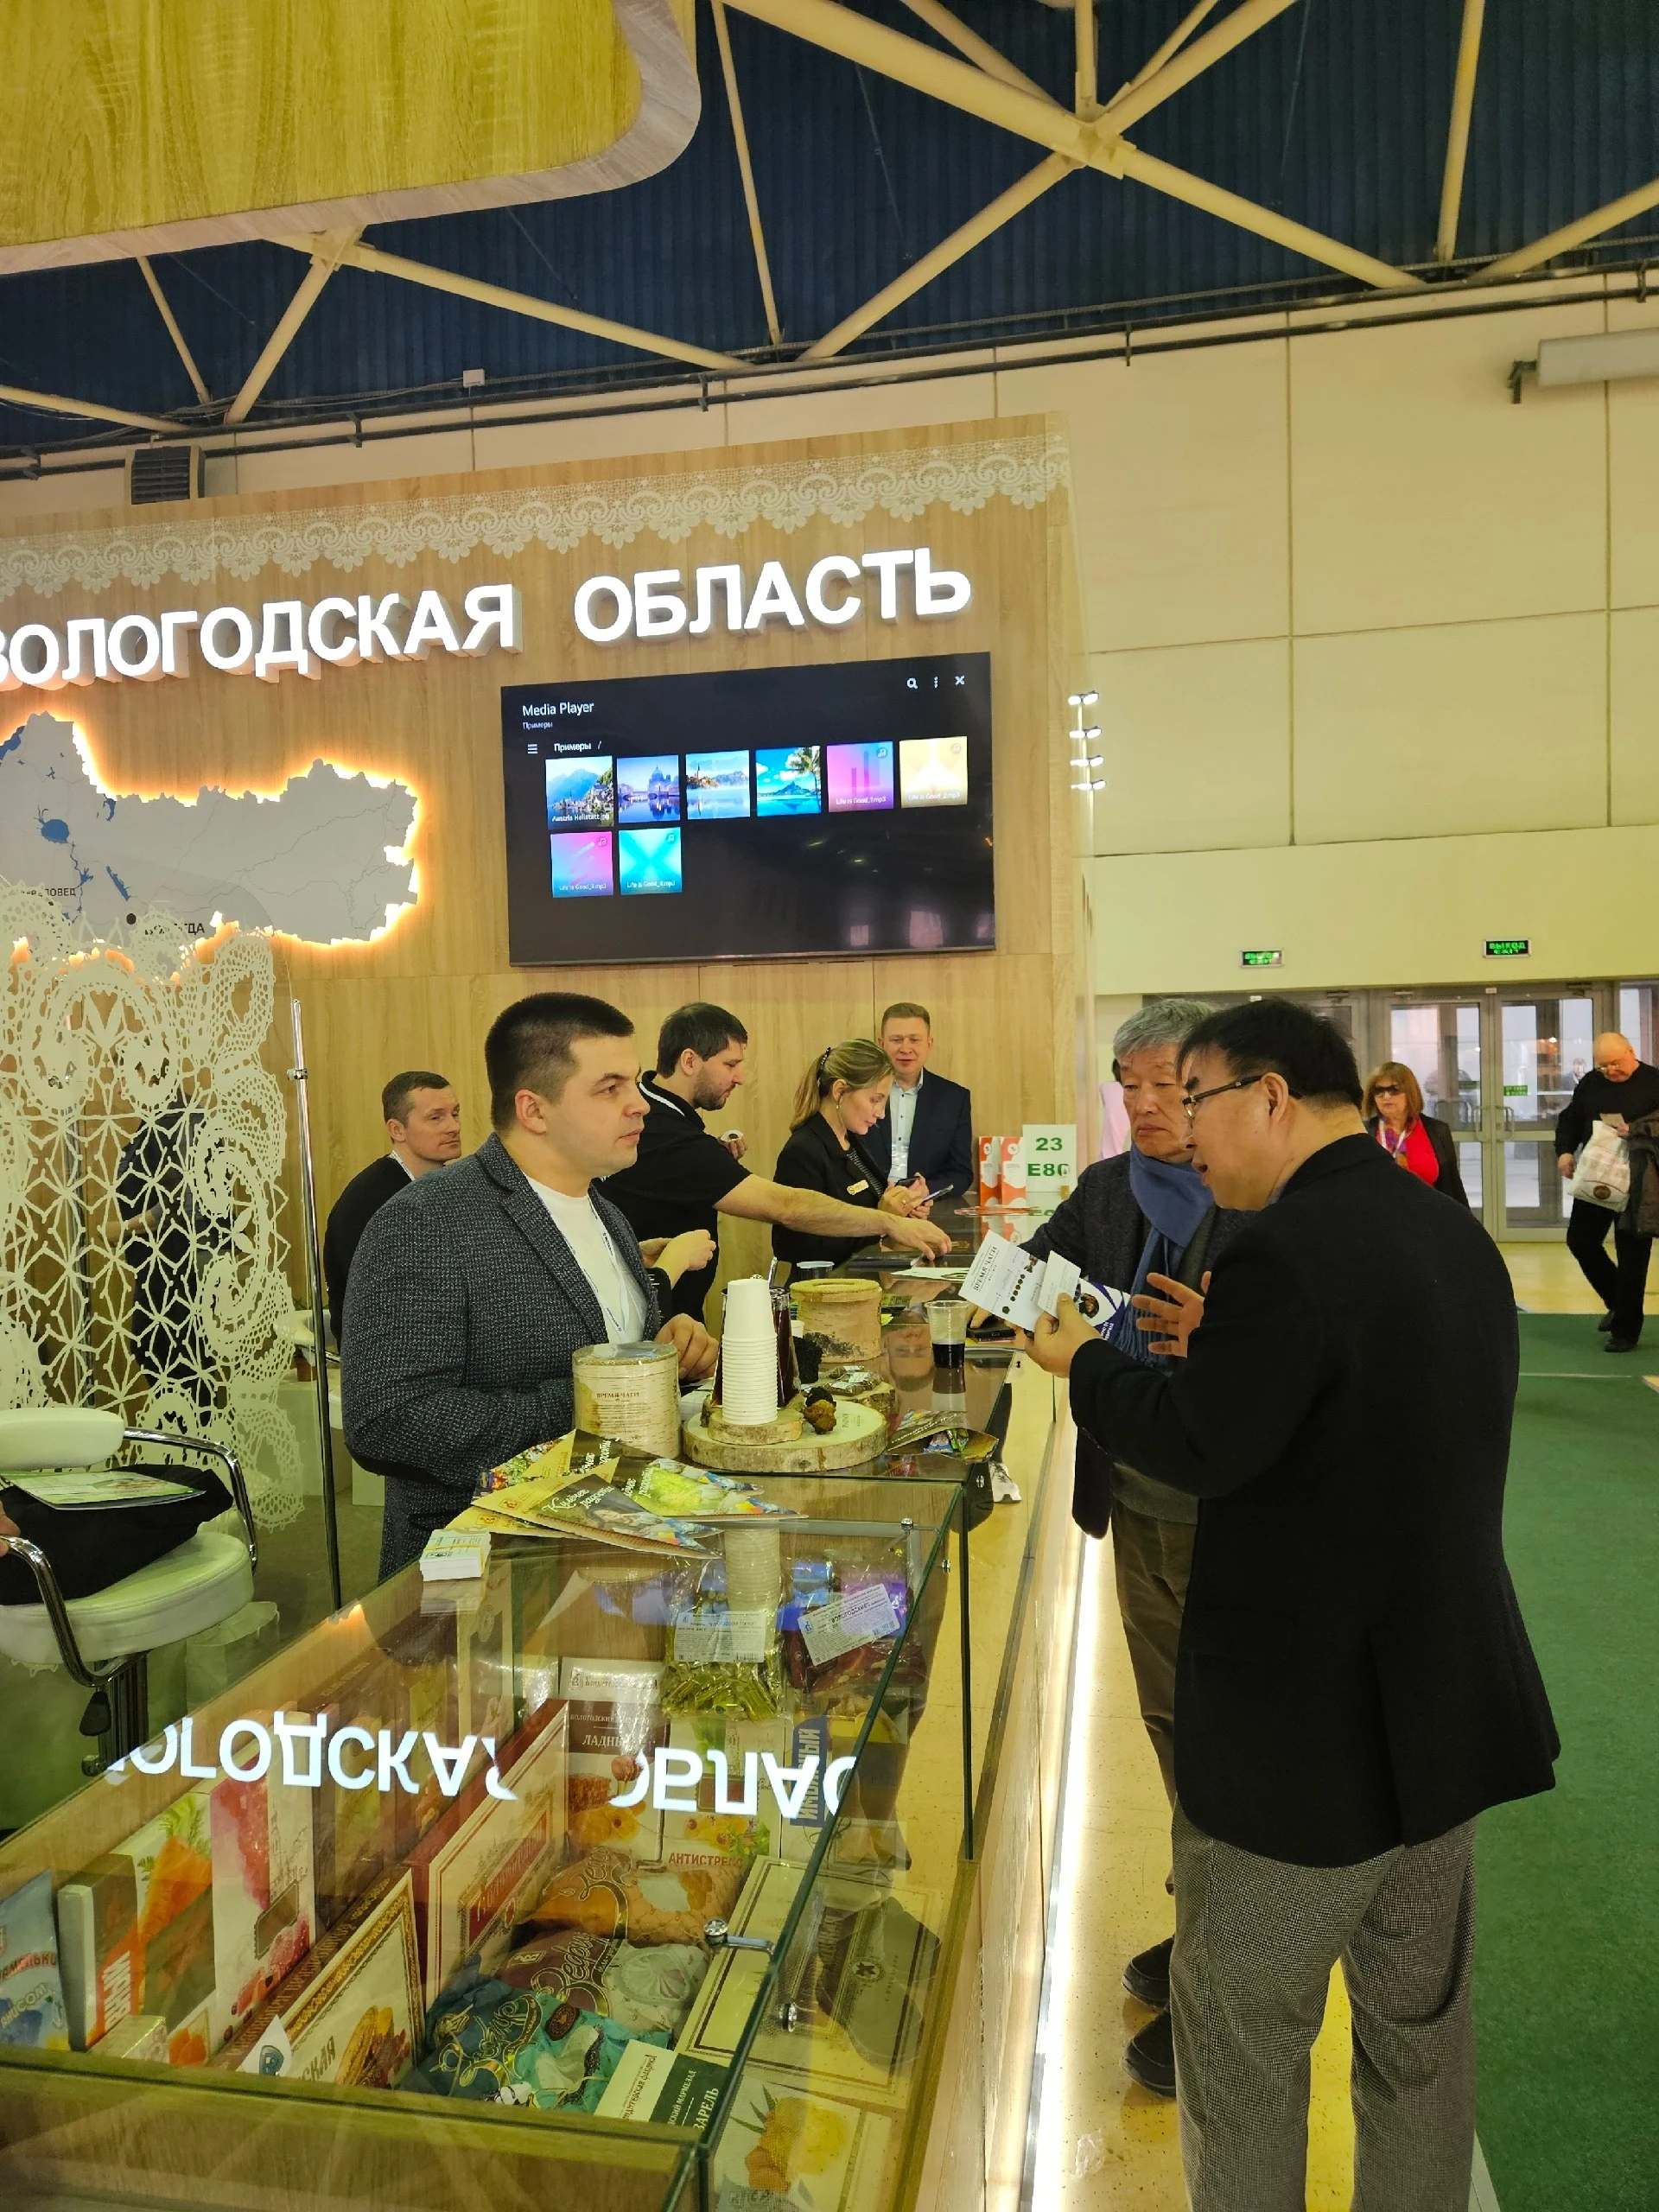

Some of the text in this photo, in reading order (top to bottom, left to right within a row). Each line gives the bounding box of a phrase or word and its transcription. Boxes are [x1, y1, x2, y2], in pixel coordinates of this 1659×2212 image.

[0, 547, 972, 688] ОЛОГОДСКАЯ ОБЛАСТЬ
[522, 702, 594, 716] Media Player
[523, 721, 553, 730] Примеры
[554, 742, 592, 753] Примеры
[1035, 1137, 1063, 1151] 23
[676, 2069, 697, 2105] МАРМЕЛАД
